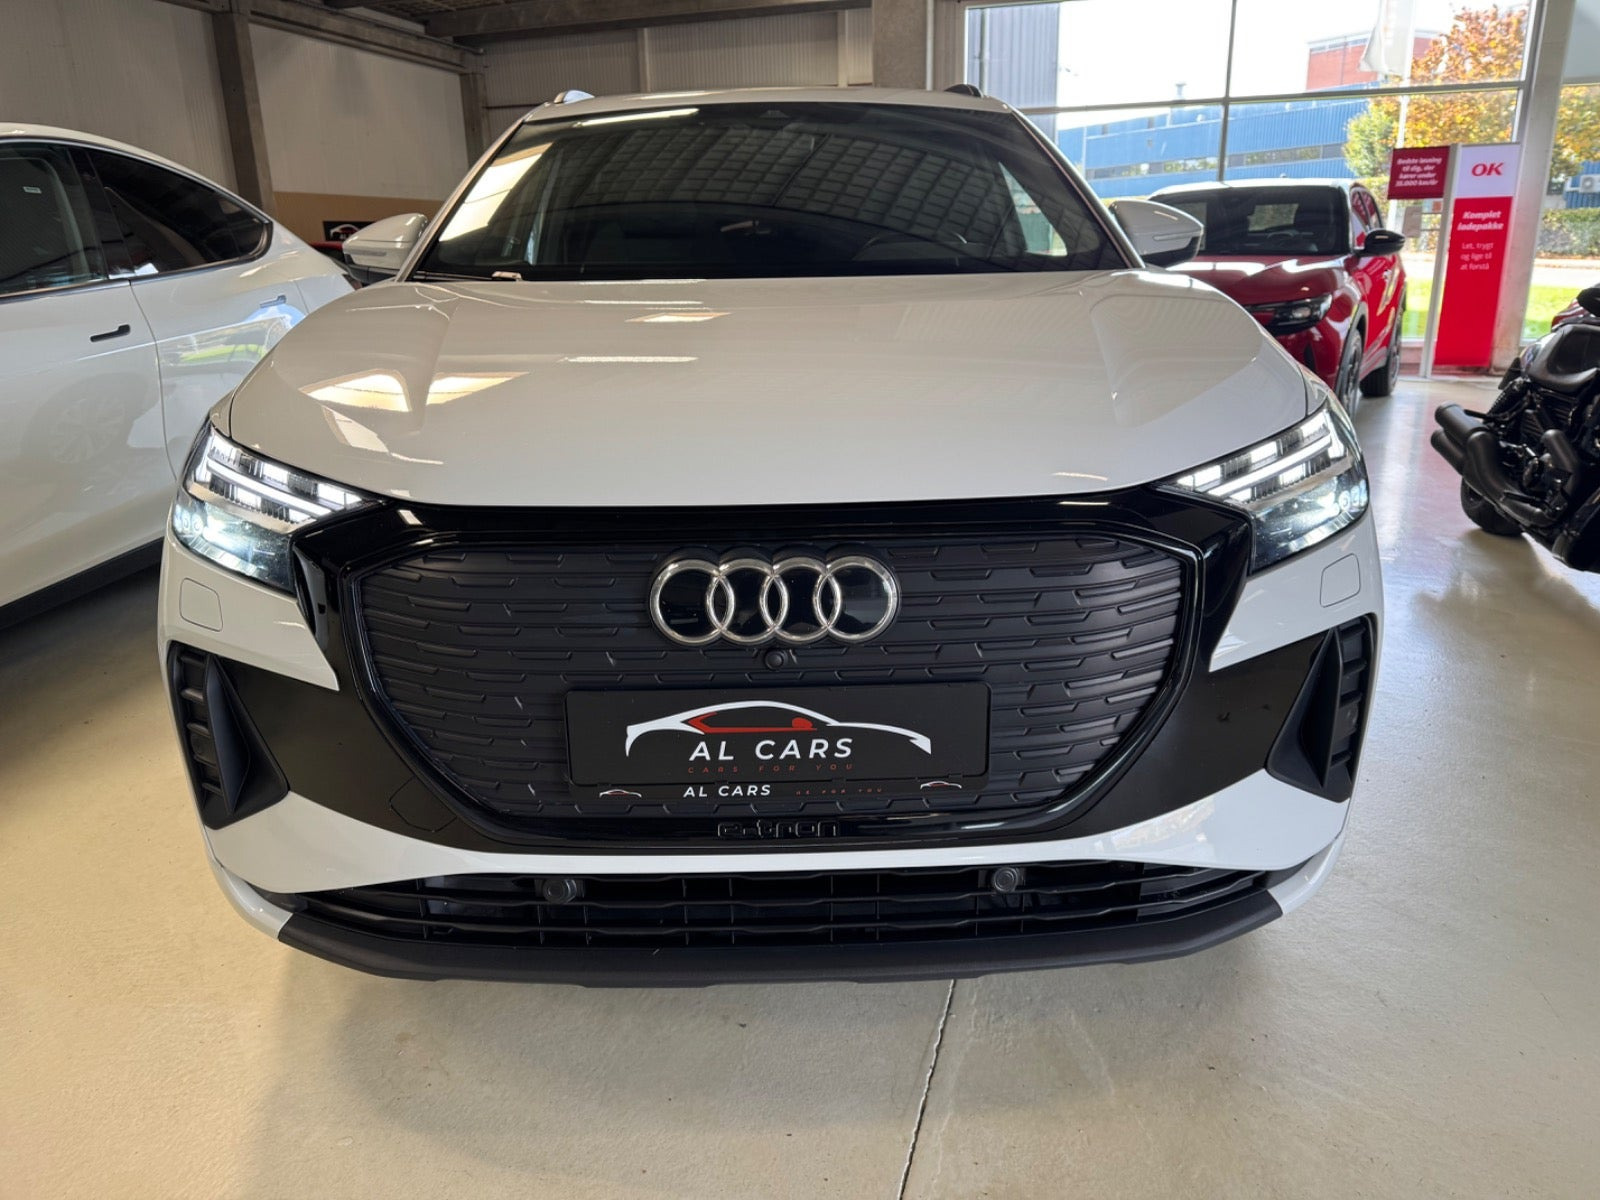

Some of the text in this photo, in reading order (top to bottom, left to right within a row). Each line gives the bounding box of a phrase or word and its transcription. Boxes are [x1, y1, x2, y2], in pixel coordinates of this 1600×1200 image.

[1471, 162, 1504, 177] OK
[1462, 210, 1502, 220] Komplet
[1457, 221, 1504, 232] ladepakke
[688, 738, 853, 761] AL CARS
[688, 763, 853, 774] CARS FOR YOU
[682, 786, 708, 798] AL
[718, 784, 771, 796] CARS
